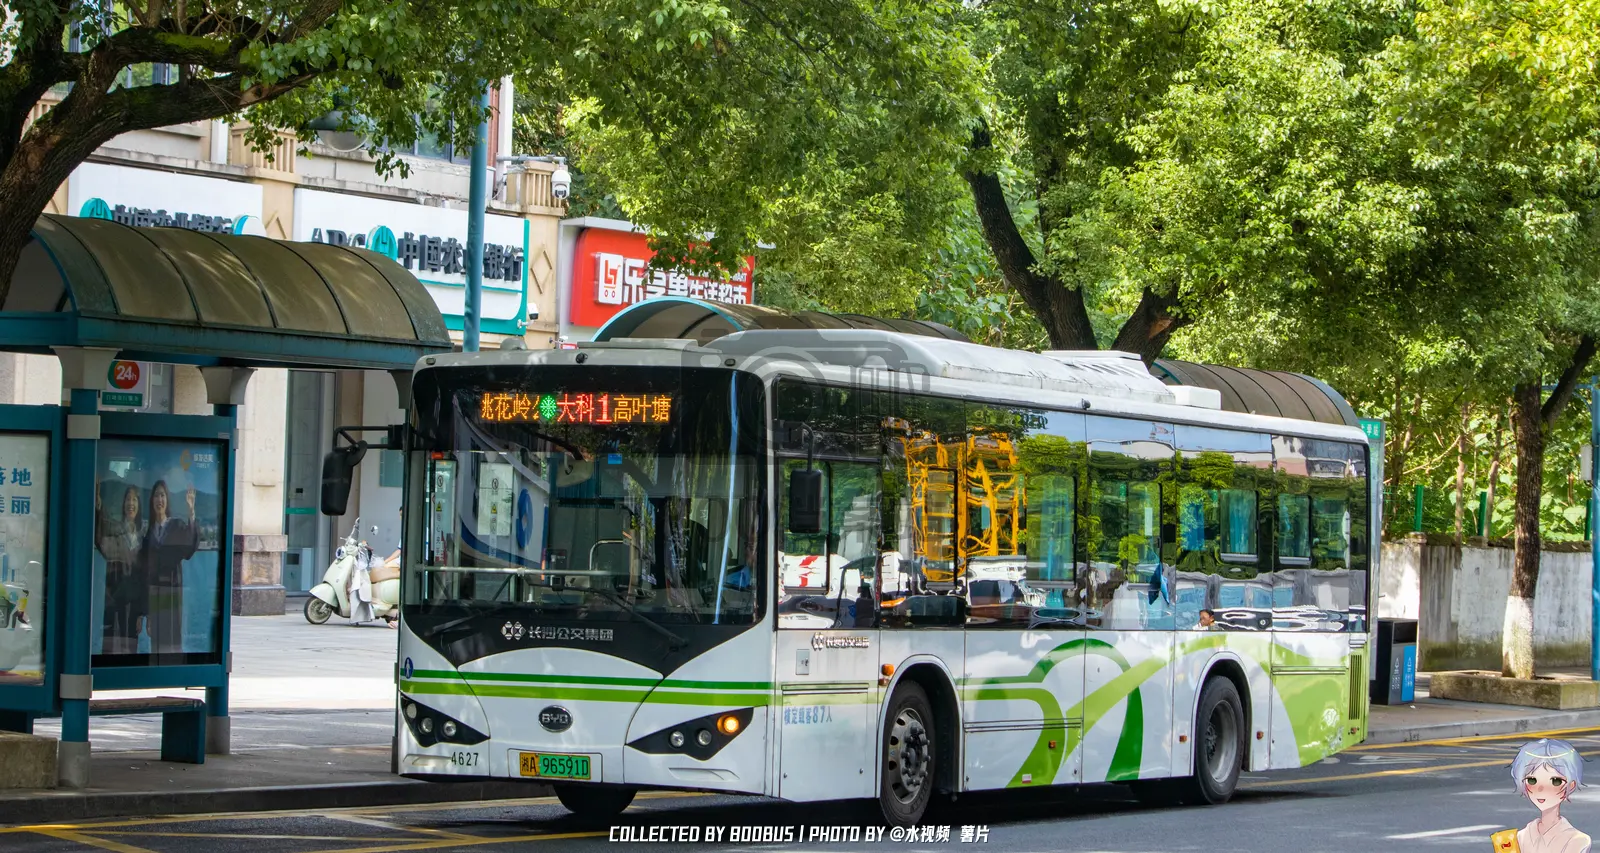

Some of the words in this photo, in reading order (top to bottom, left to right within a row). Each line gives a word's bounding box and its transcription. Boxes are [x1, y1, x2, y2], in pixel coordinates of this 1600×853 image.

[397, 231, 524, 282] 中国农银行
[116, 365, 137, 380] 24h
[613, 394, 671, 423] 高叶塘
[0, 466, 32, 486] 地
[0, 495, 31, 515] 丽
[541, 713, 568, 724] BYD
[451, 752, 479, 767] 4627
